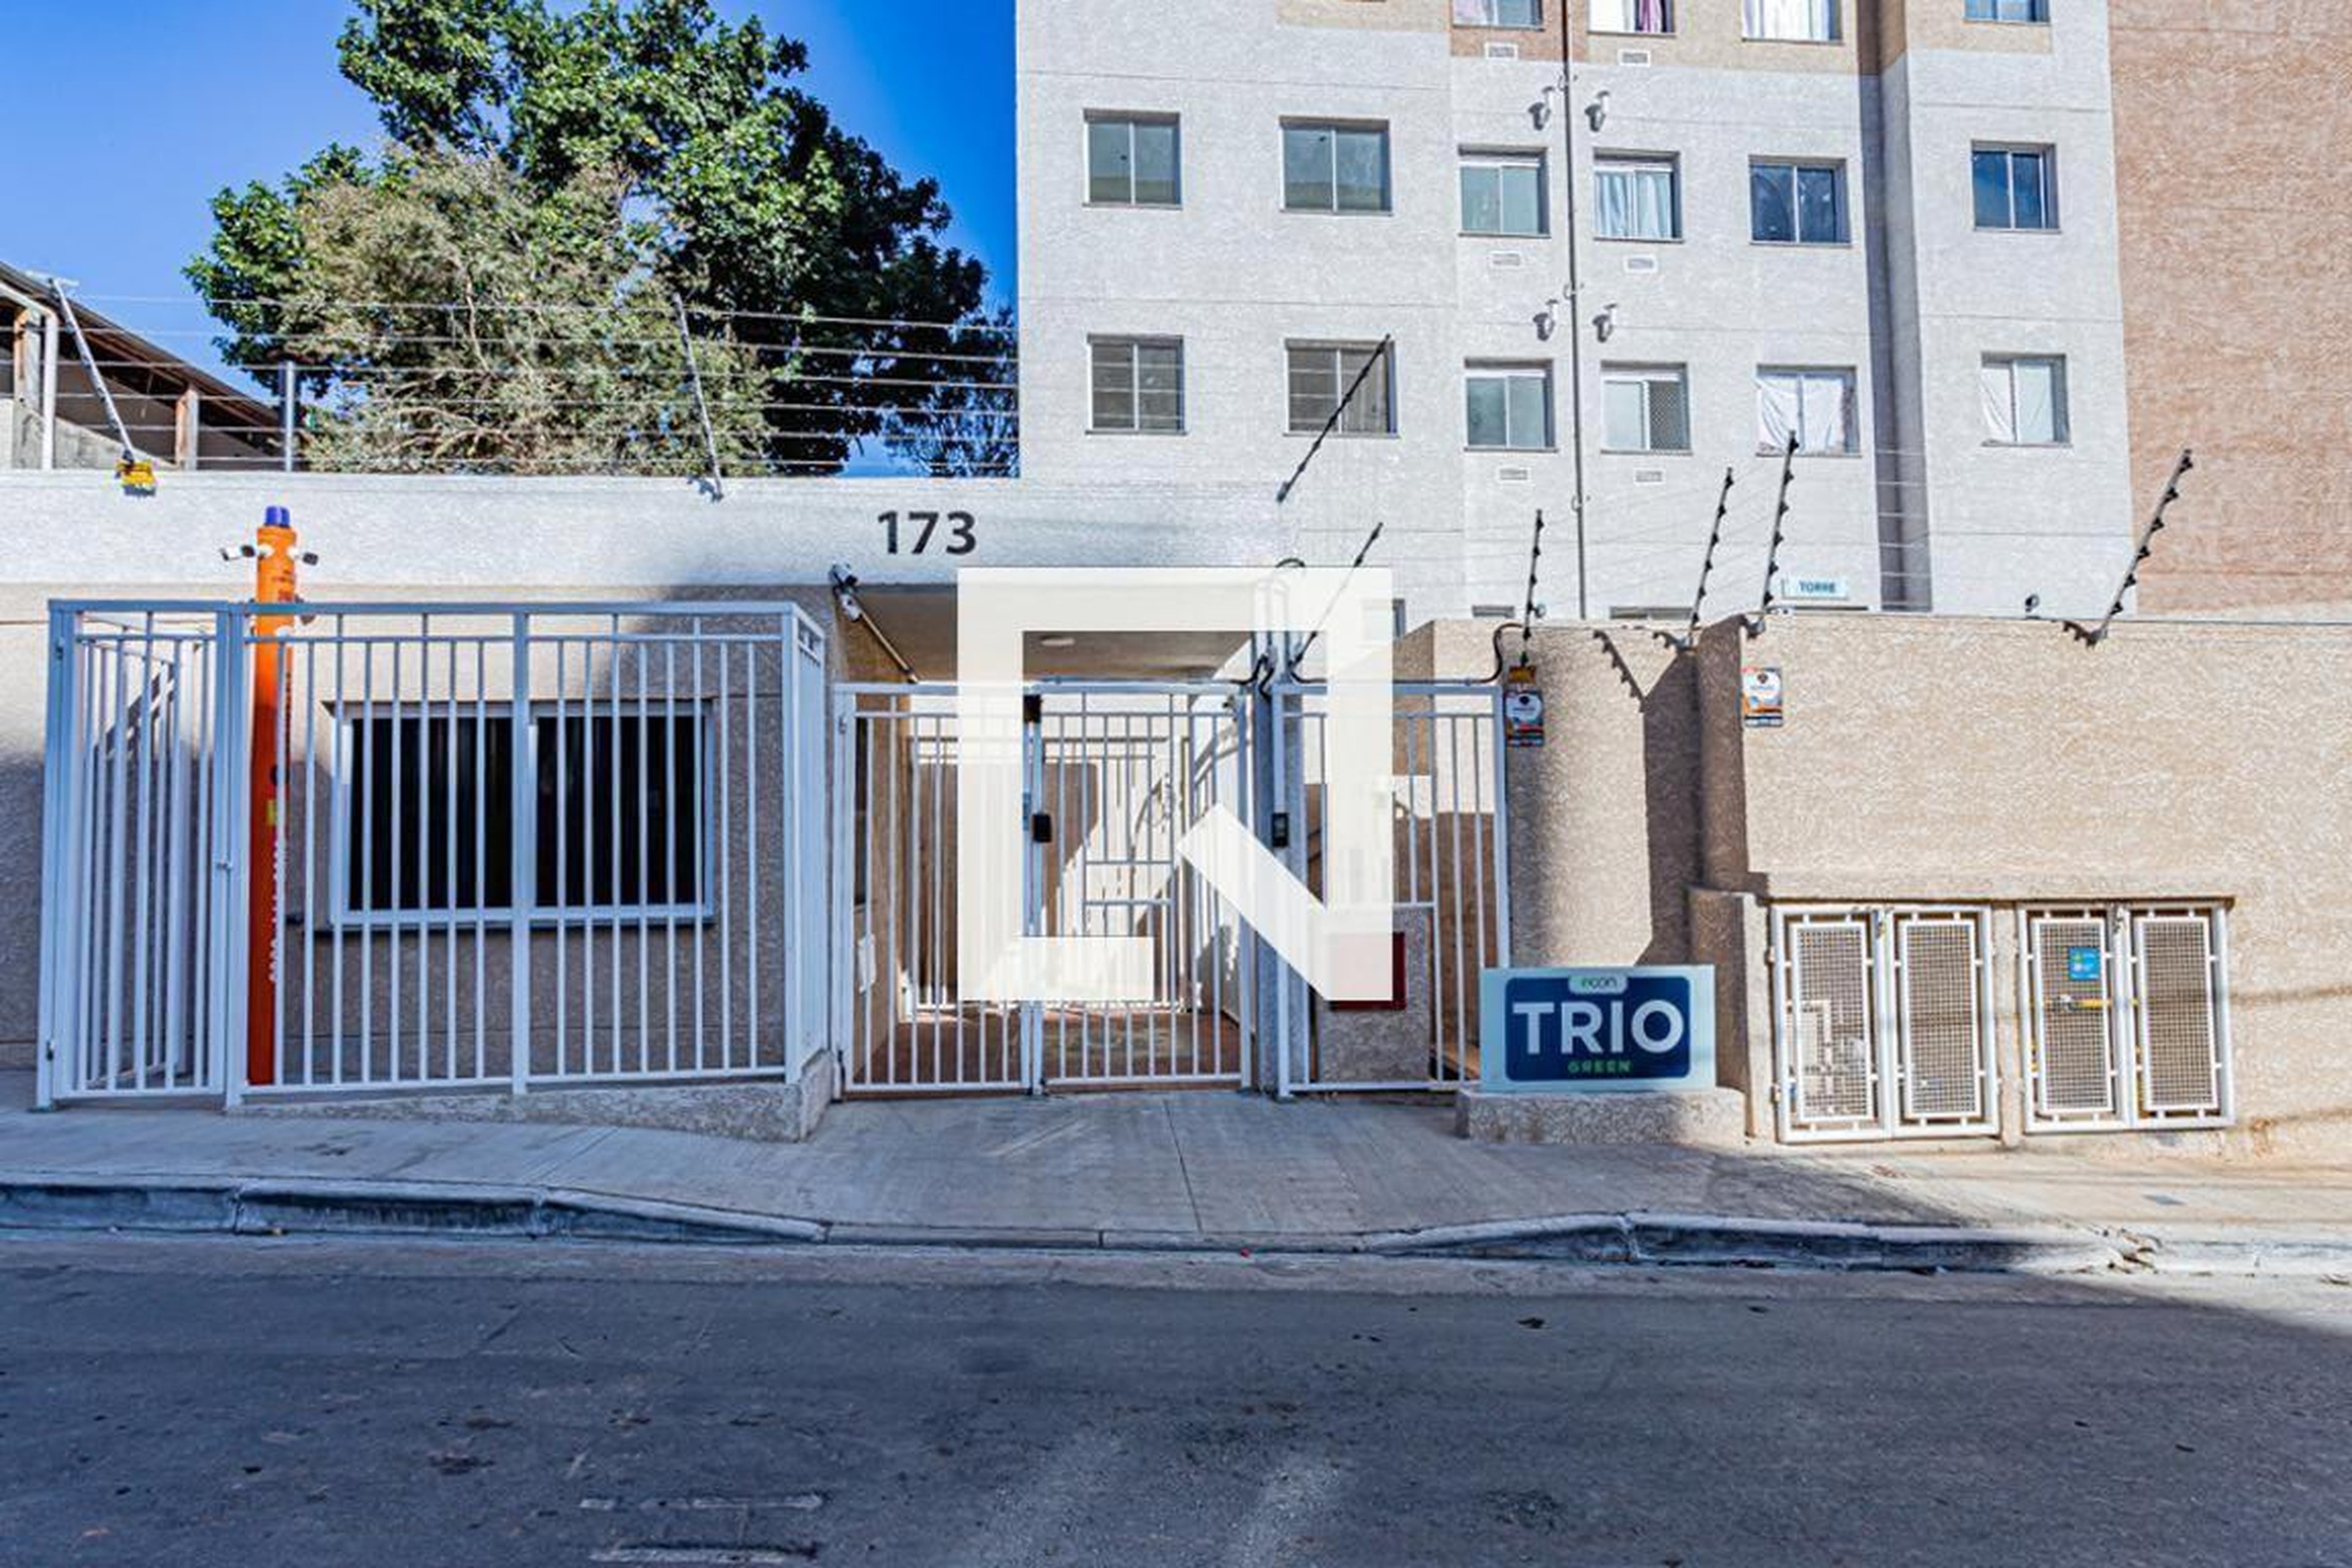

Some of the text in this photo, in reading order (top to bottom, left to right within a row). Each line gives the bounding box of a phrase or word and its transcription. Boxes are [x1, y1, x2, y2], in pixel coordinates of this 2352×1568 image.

[877, 510, 977, 555] 173
[1512, 999, 1684, 1055] TRIO
[1567, 1059, 1633, 1074] GREEN
